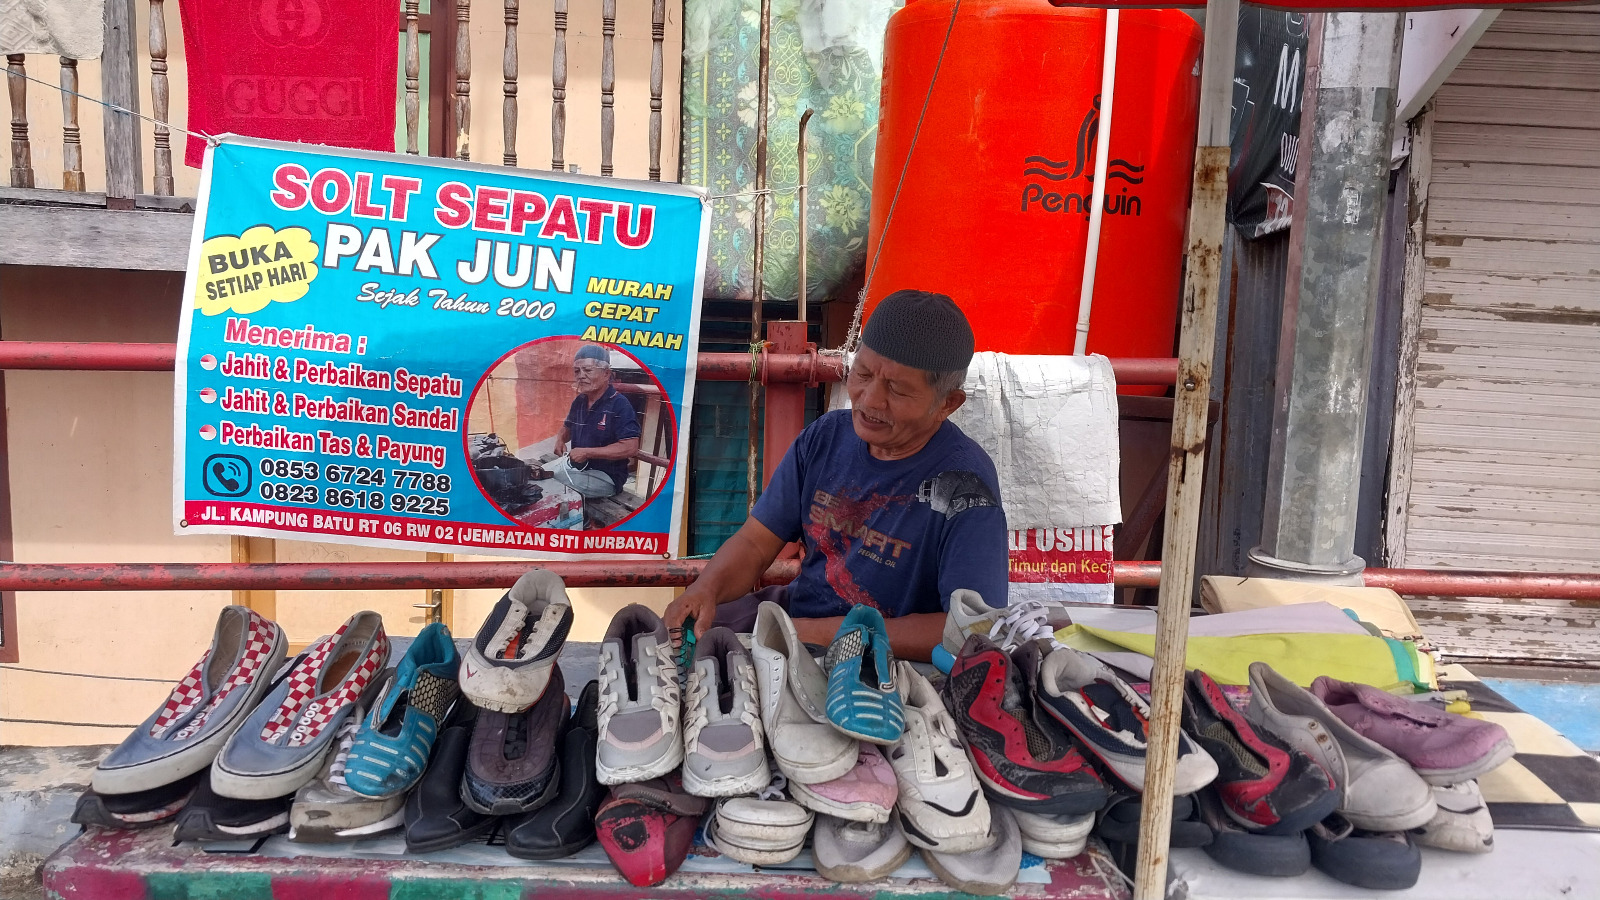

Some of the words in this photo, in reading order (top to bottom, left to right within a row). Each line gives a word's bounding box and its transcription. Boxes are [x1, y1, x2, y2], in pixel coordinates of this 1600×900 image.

[270, 163, 422, 222] SOLT
[434, 181, 656, 249] SEPATU
[207, 241, 293, 274] BUKA
[322, 222, 445, 280] PAK
[456, 238, 577, 294] JUN
[205, 272, 263, 300] SETIAP
[266, 261, 307, 287] HARI
[585, 276, 673, 301] MURAH
[357, 281, 421, 308] Sejak
[428, 289, 491, 314] Tahun
[497, 297, 556, 321] 2000
[584, 301, 660, 323] CEPAT
[224, 317, 351, 353] Menerima
[580, 325, 684, 350] AMANAH
[220, 351, 270, 379] Jahit
[274, 356, 290, 381] &
[295, 357, 391, 391] Perbaikan
[394, 368, 463, 399] Sepatu
[220, 387, 270, 414] Jahit
[273, 391, 290, 416] &
[293, 393, 389, 425] Perbaikan
[392, 402, 459, 431] Sandal
[220, 420, 315, 453] Perbaikan
[317, 430, 351, 456] Tas
[356, 435, 373, 458] &
[376, 436, 446, 468] Payung
[260, 458, 319, 480] 0853
[325, 465, 385, 487] 6724
[393, 470, 451, 493] 7788
[260, 482, 319, 503] 0823
[325, 487, 384, 510] 8618
[391, 494, 450, 516] 9225
[201, 506, 226, 521] JL.
[230, 507, 308, 528] KAMPUNG
[313, 514, 354, 532] BATU
[358, 518, 379, 534] RT
[383, 520, 402, 536] 06
[406, 523, 430, 538] RW
[435, 525, 454, 540] 02
[457, 526, 545, 548] (JEMBATAN
[549, 533, 579, 549] SITI
[583, 536, 659, 553] NURBAYA)
[809, 504, 912, 559] SMART
[857, 548, 883, 564] FEDERAL
[884, 558, 897, 568] OIL
[1008, 559, 1046, 573] Timur
[1050, 559, 1077, 573] dan
